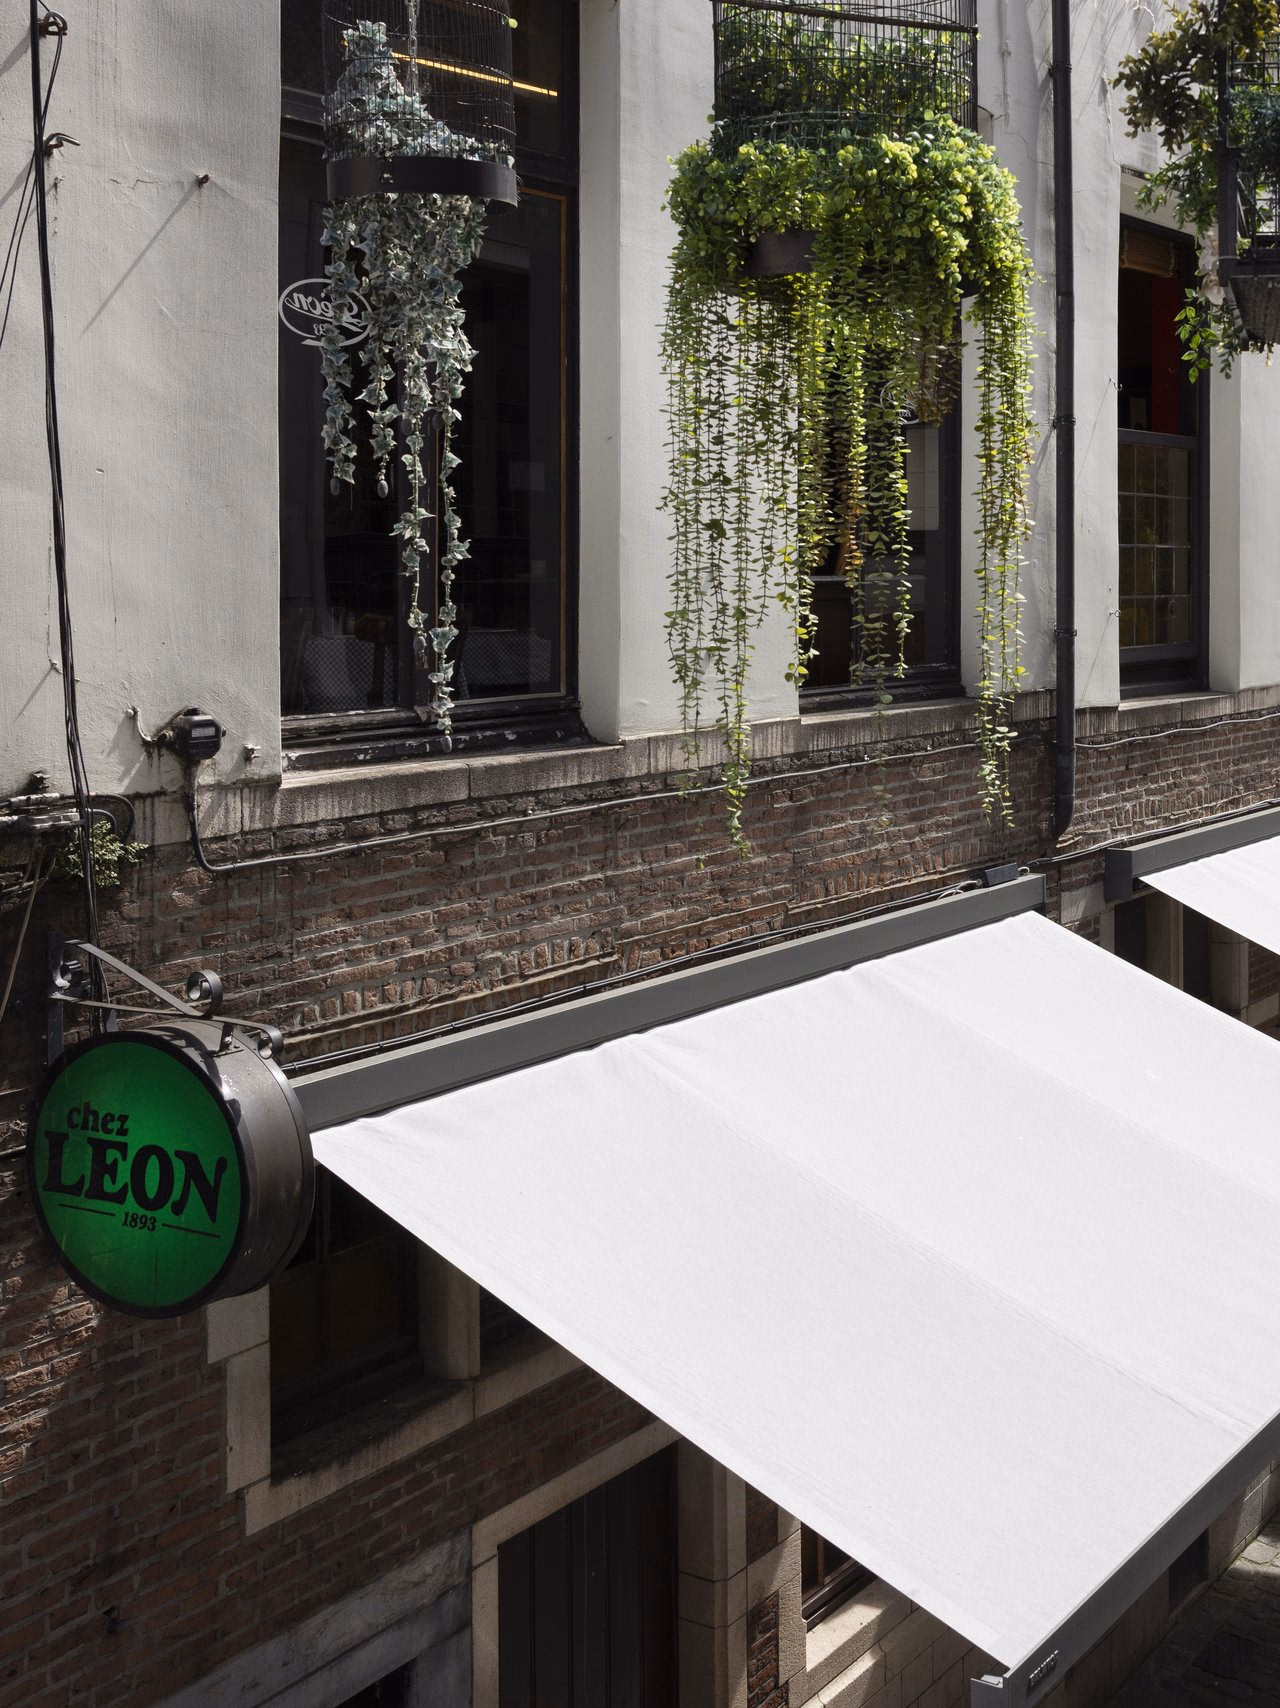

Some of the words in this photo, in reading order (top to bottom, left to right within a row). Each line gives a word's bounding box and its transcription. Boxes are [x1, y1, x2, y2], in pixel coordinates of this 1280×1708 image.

[67, 1102, 129, 1137] chez
[42, 1131, 228, 1223] LEON
[122, 1211, 157, 1232] 1893
